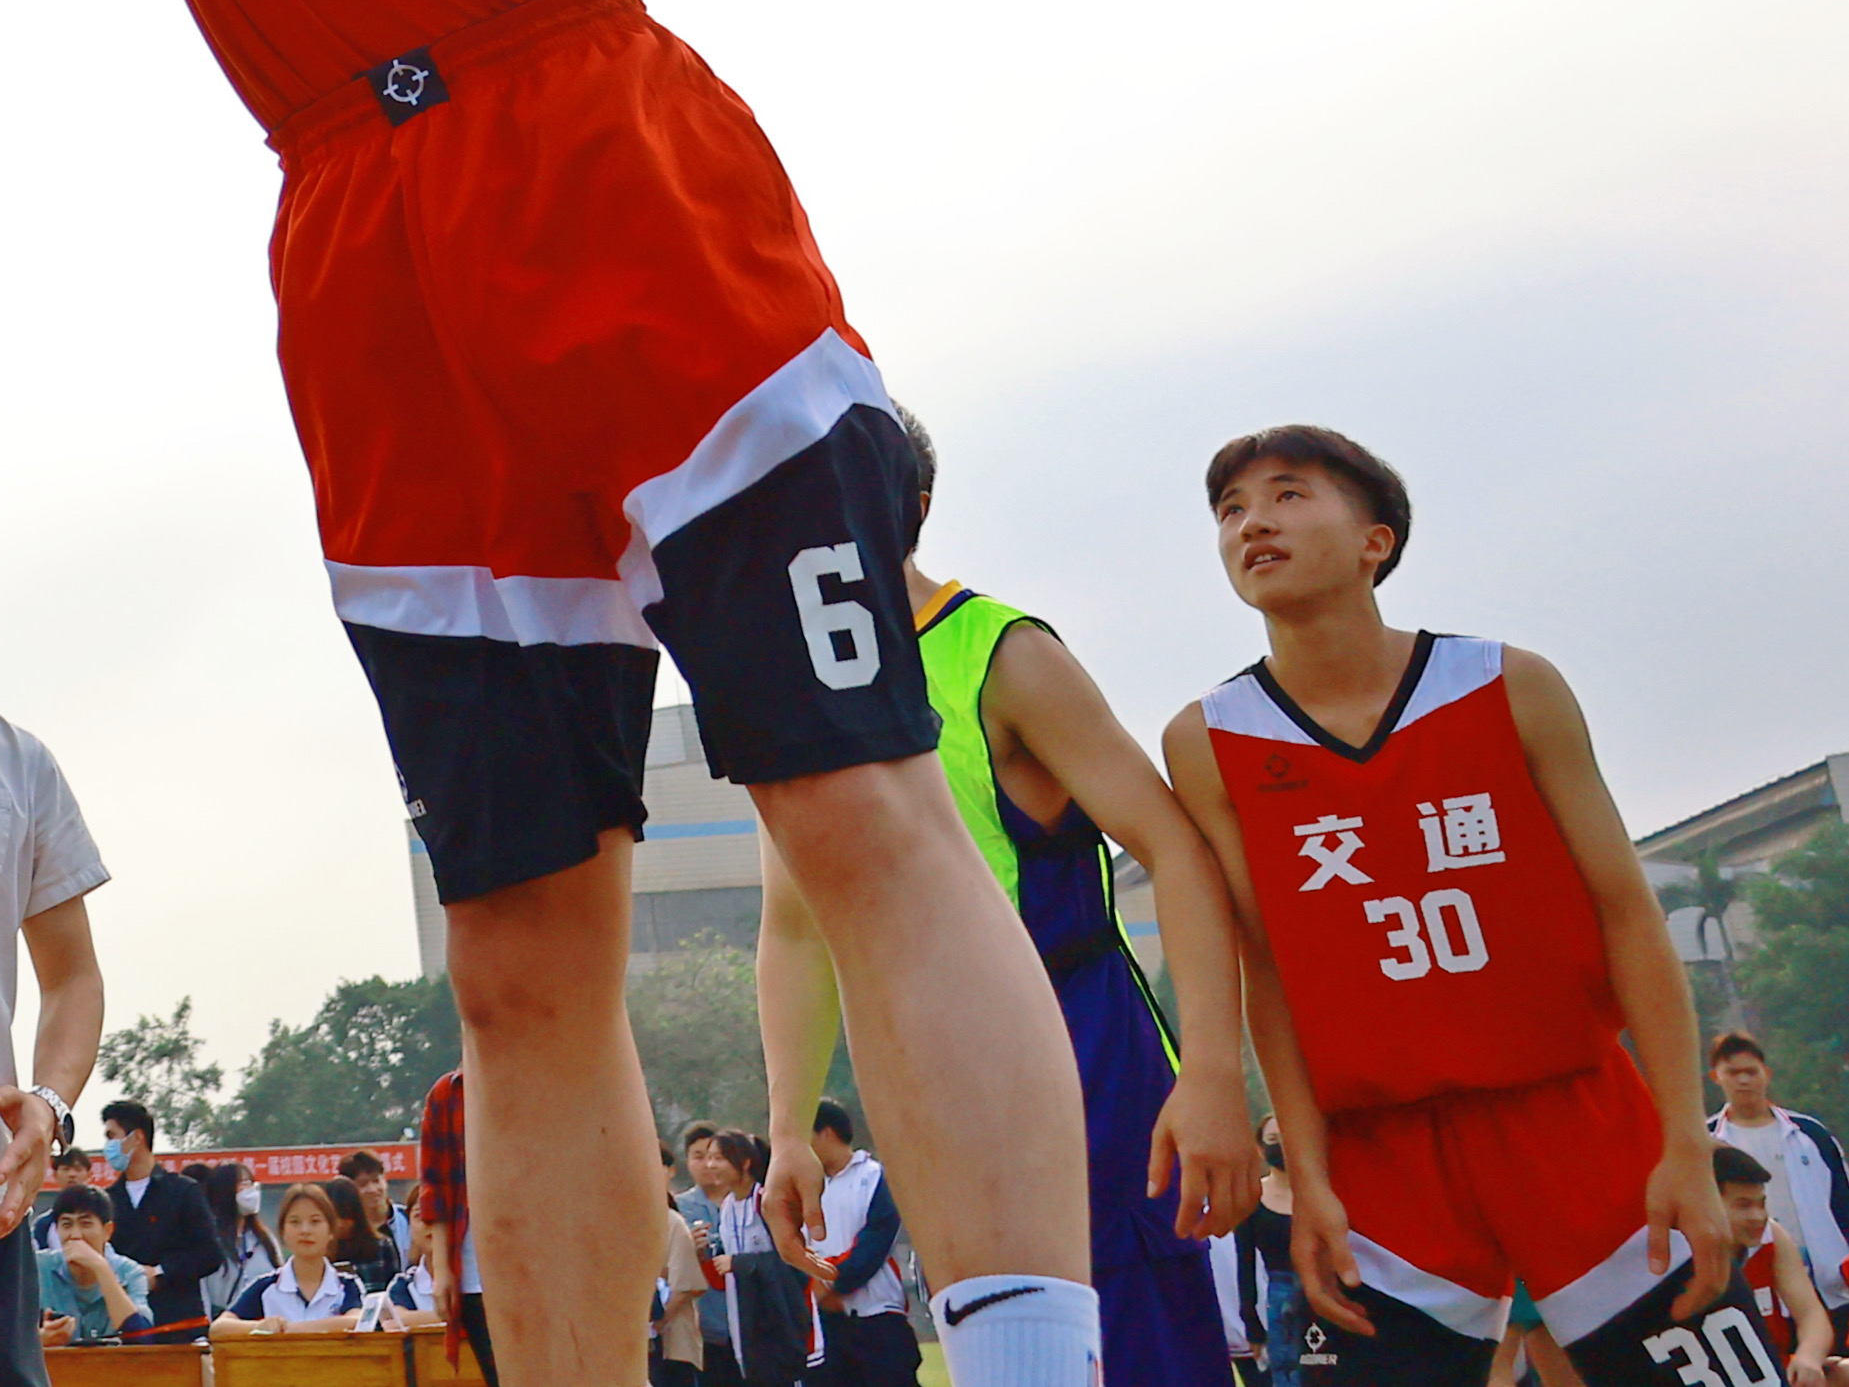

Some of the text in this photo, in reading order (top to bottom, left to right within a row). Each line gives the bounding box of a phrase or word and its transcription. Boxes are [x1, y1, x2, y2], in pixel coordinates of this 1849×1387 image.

[787, 541, 882, 691] 6
[1292, 791, 1507, 893] 交通
[1363, 887, 1490, 982] 30
[1641, 1305, 1783, 1387] 30
